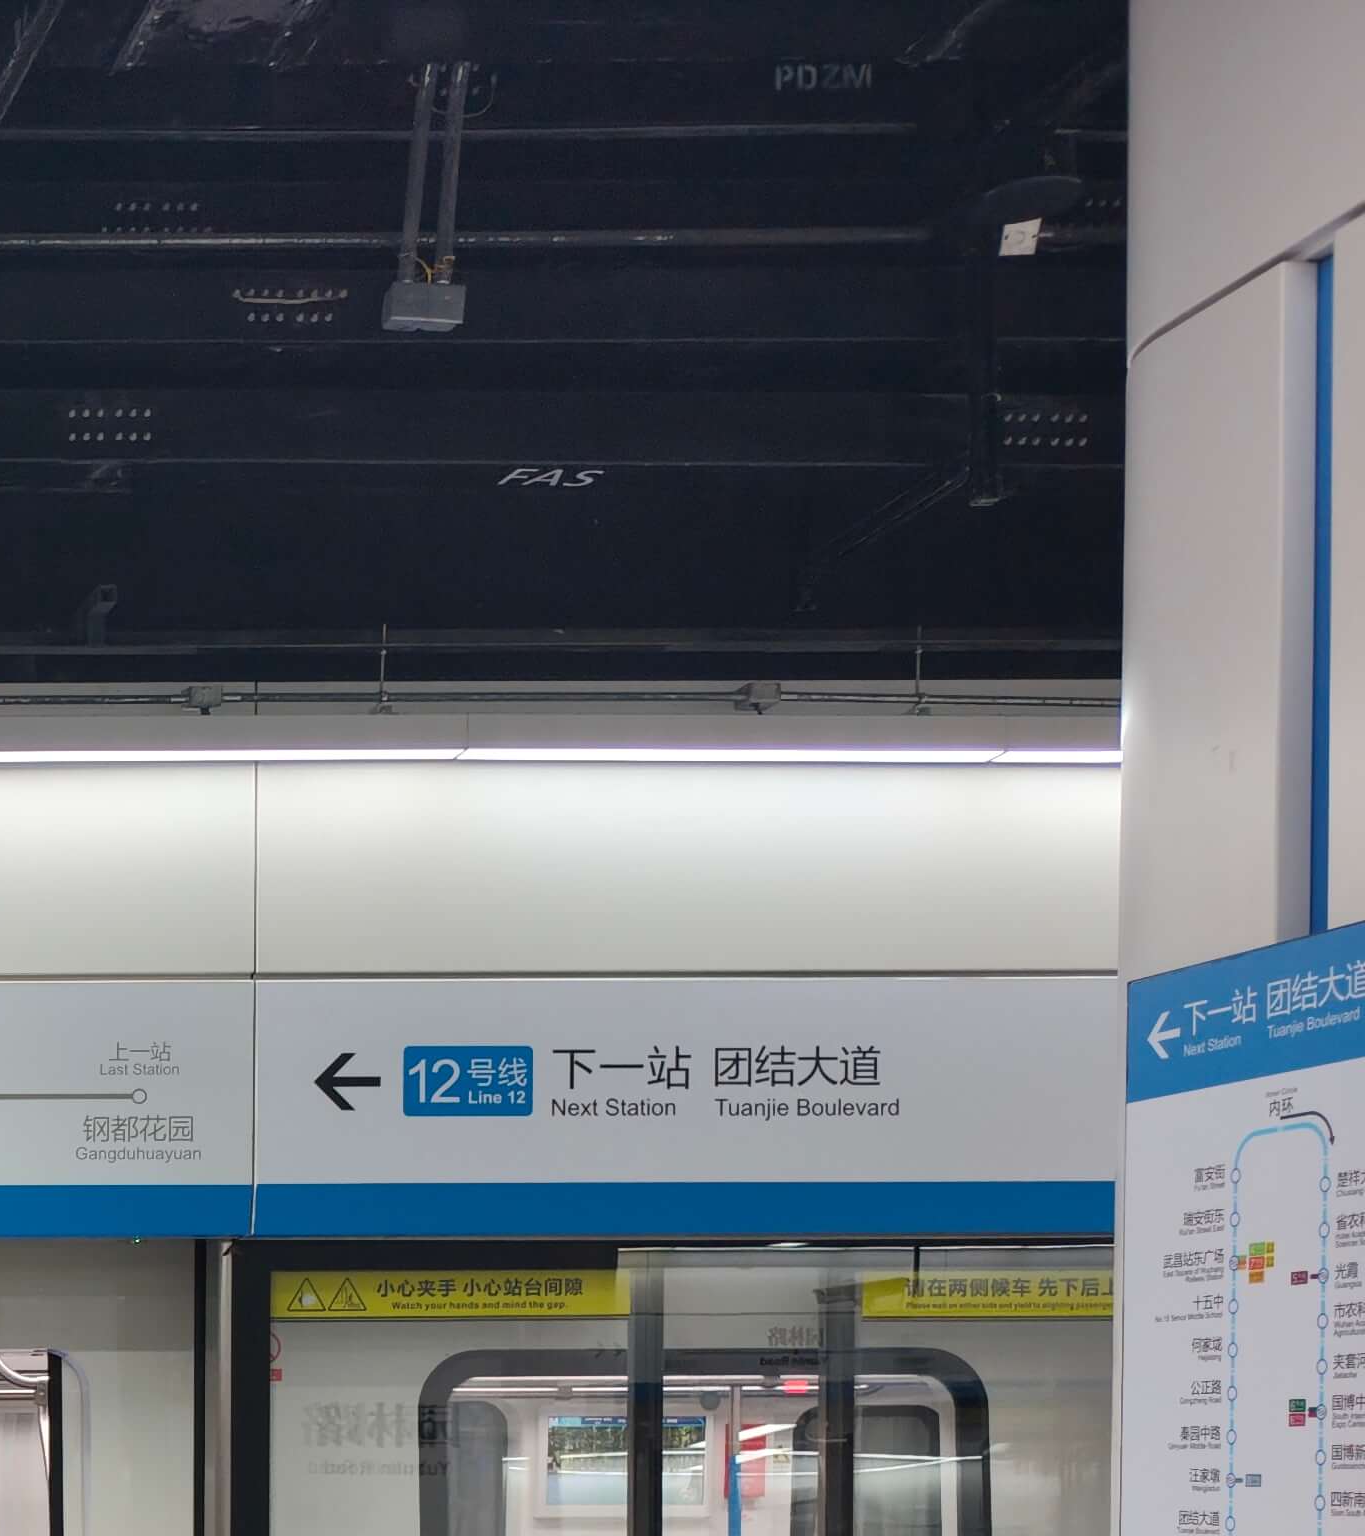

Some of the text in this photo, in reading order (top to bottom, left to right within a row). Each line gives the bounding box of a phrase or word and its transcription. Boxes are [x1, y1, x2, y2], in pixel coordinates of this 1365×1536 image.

[774, 63, 872, 91] PDZM
[498, 468, 605, 487] FAS
[1183, 960, 1365, 1036] 下一站 团结大道
[1183, 1007, 1361, 1057] Next Station Tuanjie Boulevard
[109, 1041, 171, 1062] 上一站
[100, 1063, 180, 1076] Last Station
[552, 1045, 692, 1090] 下一站
[714, 1045, 881, 1088] 团结大道
[468, 1090, 526, 1105] Line 12
[551, 1097, 900, 1122] Next Station Tuanjie Boulevard
[83, 1115, 194, 1143] 钢都花园
[75, 1146, 202, 1164] Gangduhuayuan
[376, 1278, 584, 1298] 小心夹手 小心站台间隙
[391, 1301, 422, 1311] Watch
[424, 1301, 447, 1311] your
[449, 1301, 479, 1311] hands
[481, 1301, 500, 1311] and
[502, 1301, 526, 1311] mind
[528, 1301, 544, 1311] the
[1193, 1295, 1224, 1310] 十五中
